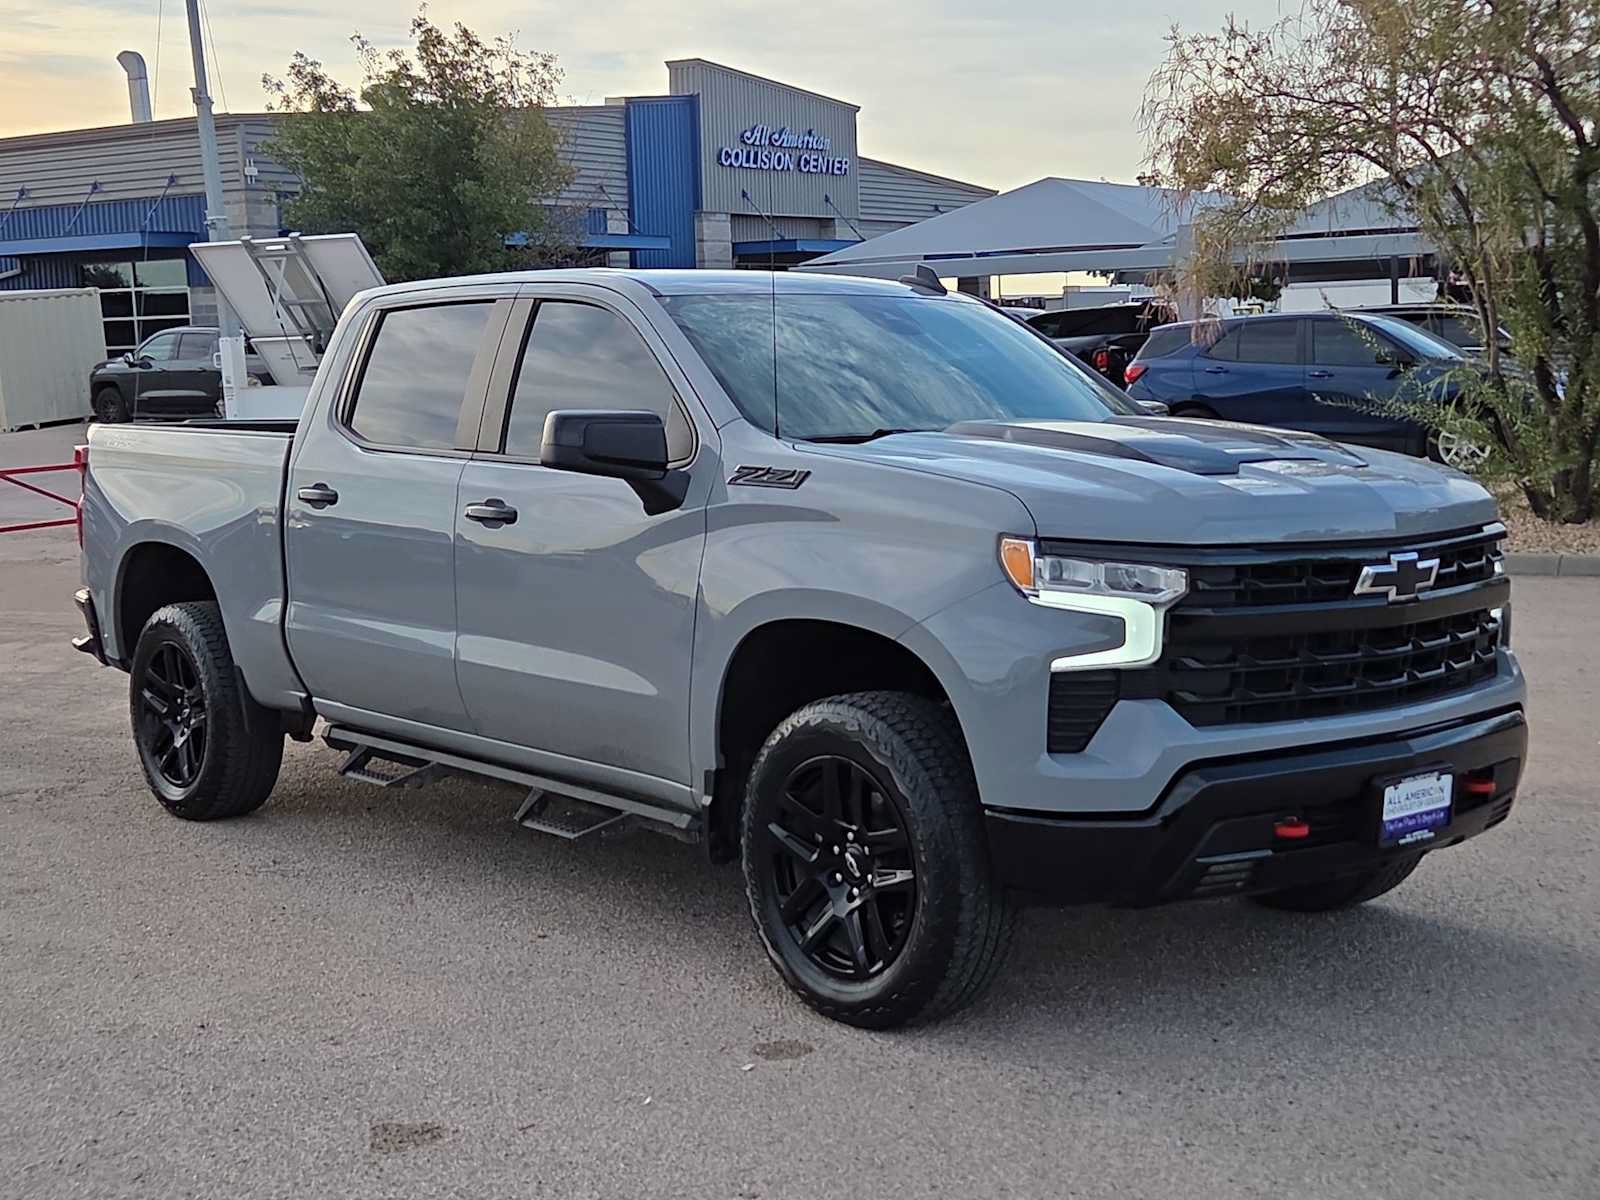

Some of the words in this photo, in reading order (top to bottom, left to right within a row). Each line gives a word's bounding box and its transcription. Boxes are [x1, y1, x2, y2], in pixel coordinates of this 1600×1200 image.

[742, 124, 769, 146] All
[770, 127, 831, 150] American
[720, 147, 794, 170] COLLISION
[800, 154, 849, 174] CENTER
[726, 464, 811, 489] Z71
[1387, 794, 1401, 805] ALL
